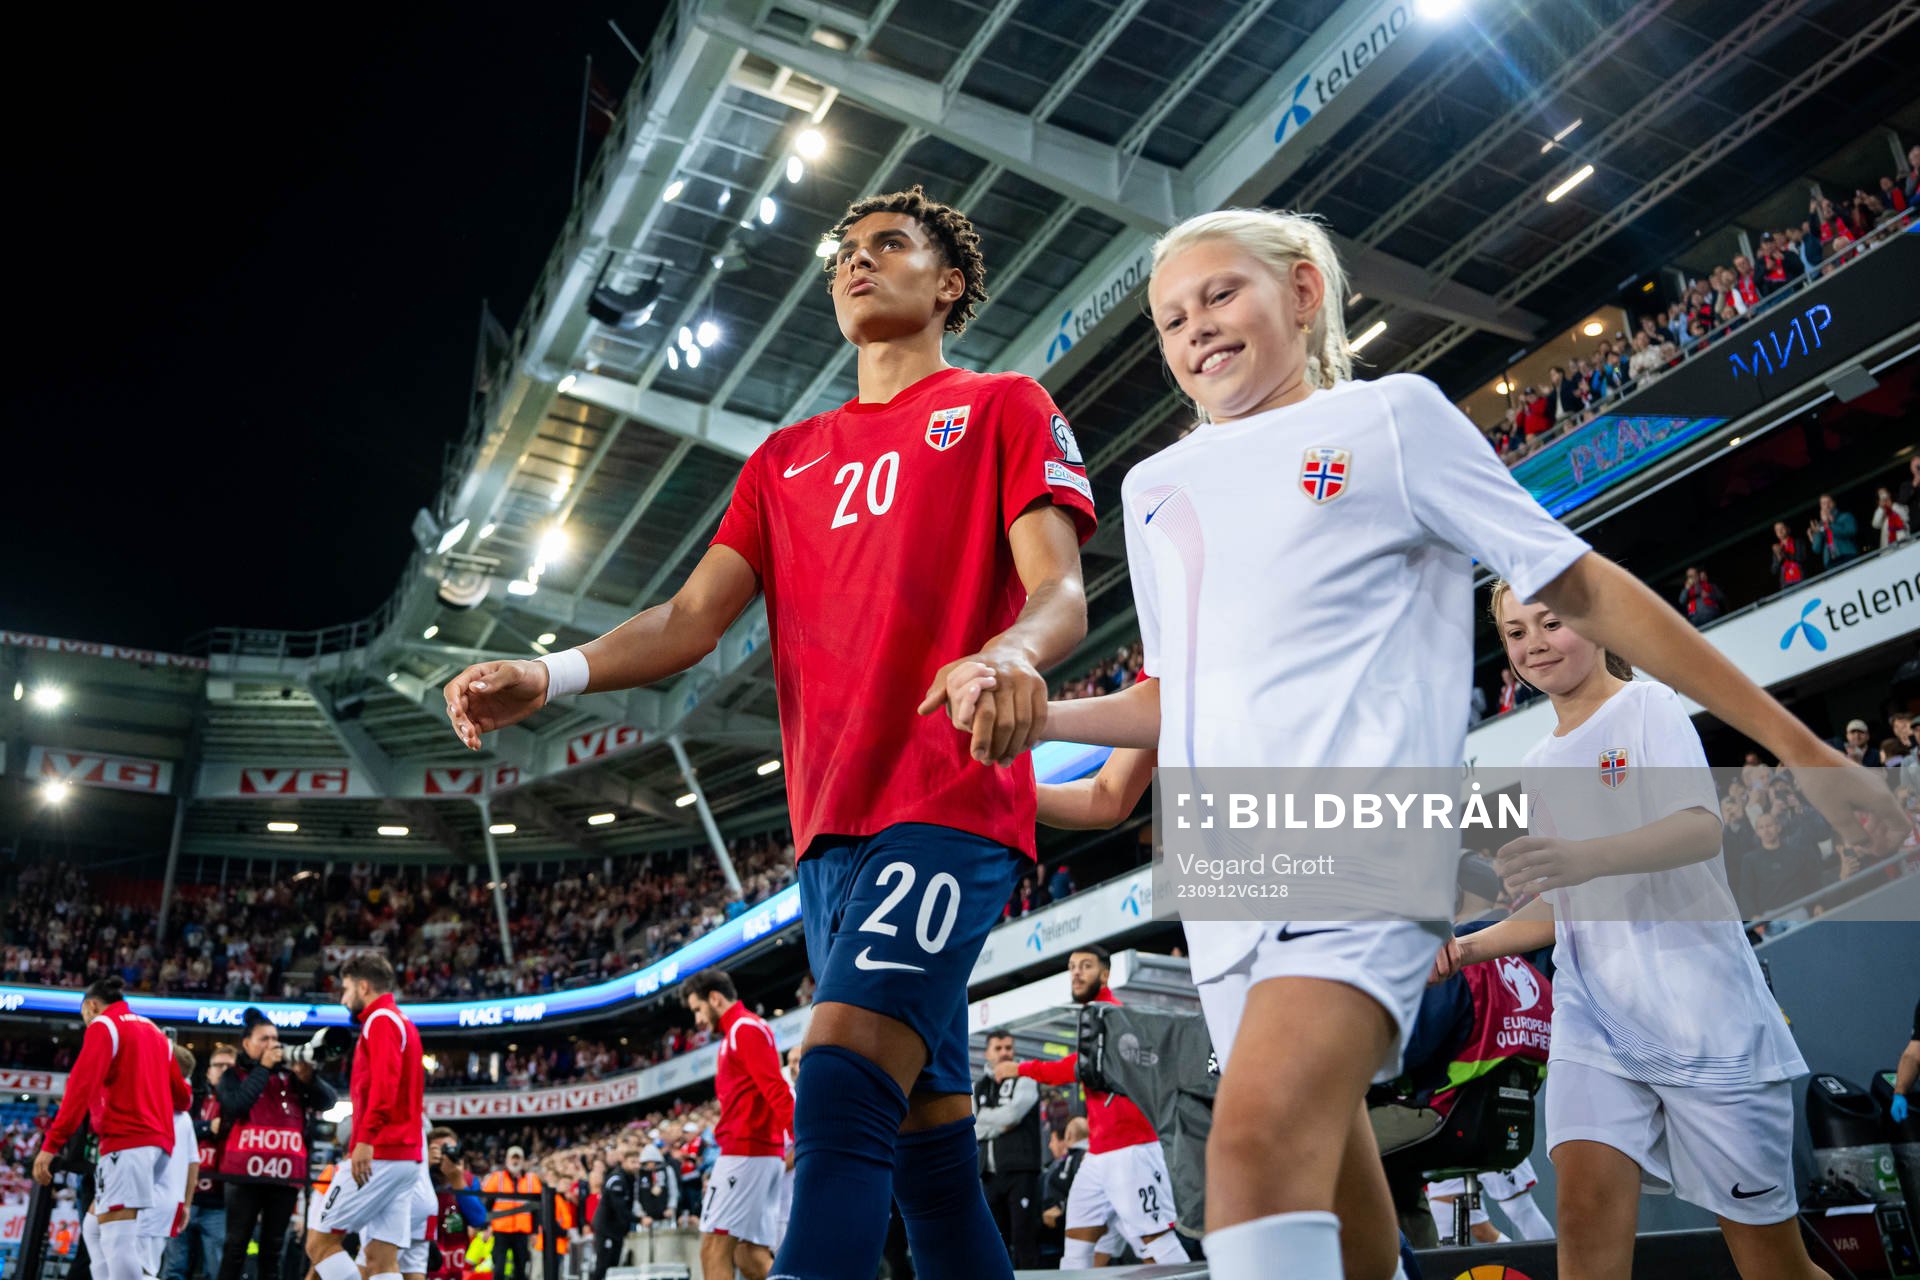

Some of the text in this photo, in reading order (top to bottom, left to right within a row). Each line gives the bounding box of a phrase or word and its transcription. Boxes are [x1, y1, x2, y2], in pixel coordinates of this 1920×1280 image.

[1315, 4, 1415, 104] teleno
[1075, 256, 1144, 338] telenor
[831, 450, 900, 530] 20
[1825, 572, 1920, 631] telen
[567, 726, 642, 765] VG
[42, 752, 159, 791] VG
[240, 768, 348, 794] VG
[858, 861, 961, 954] 20
[198, 1007, 243, 1025] PEAC
[1496, 1030, 1551, 1050] QUALIFIE
[238, 1128, 302, 1152] PHOTO
[246, 1155, 293, 1179] 040
[325, 1185, 341, 1210] 9
[1138, 1185, 1160, 1213] 22
[1832, 1236, 1860, 1250] VAR
